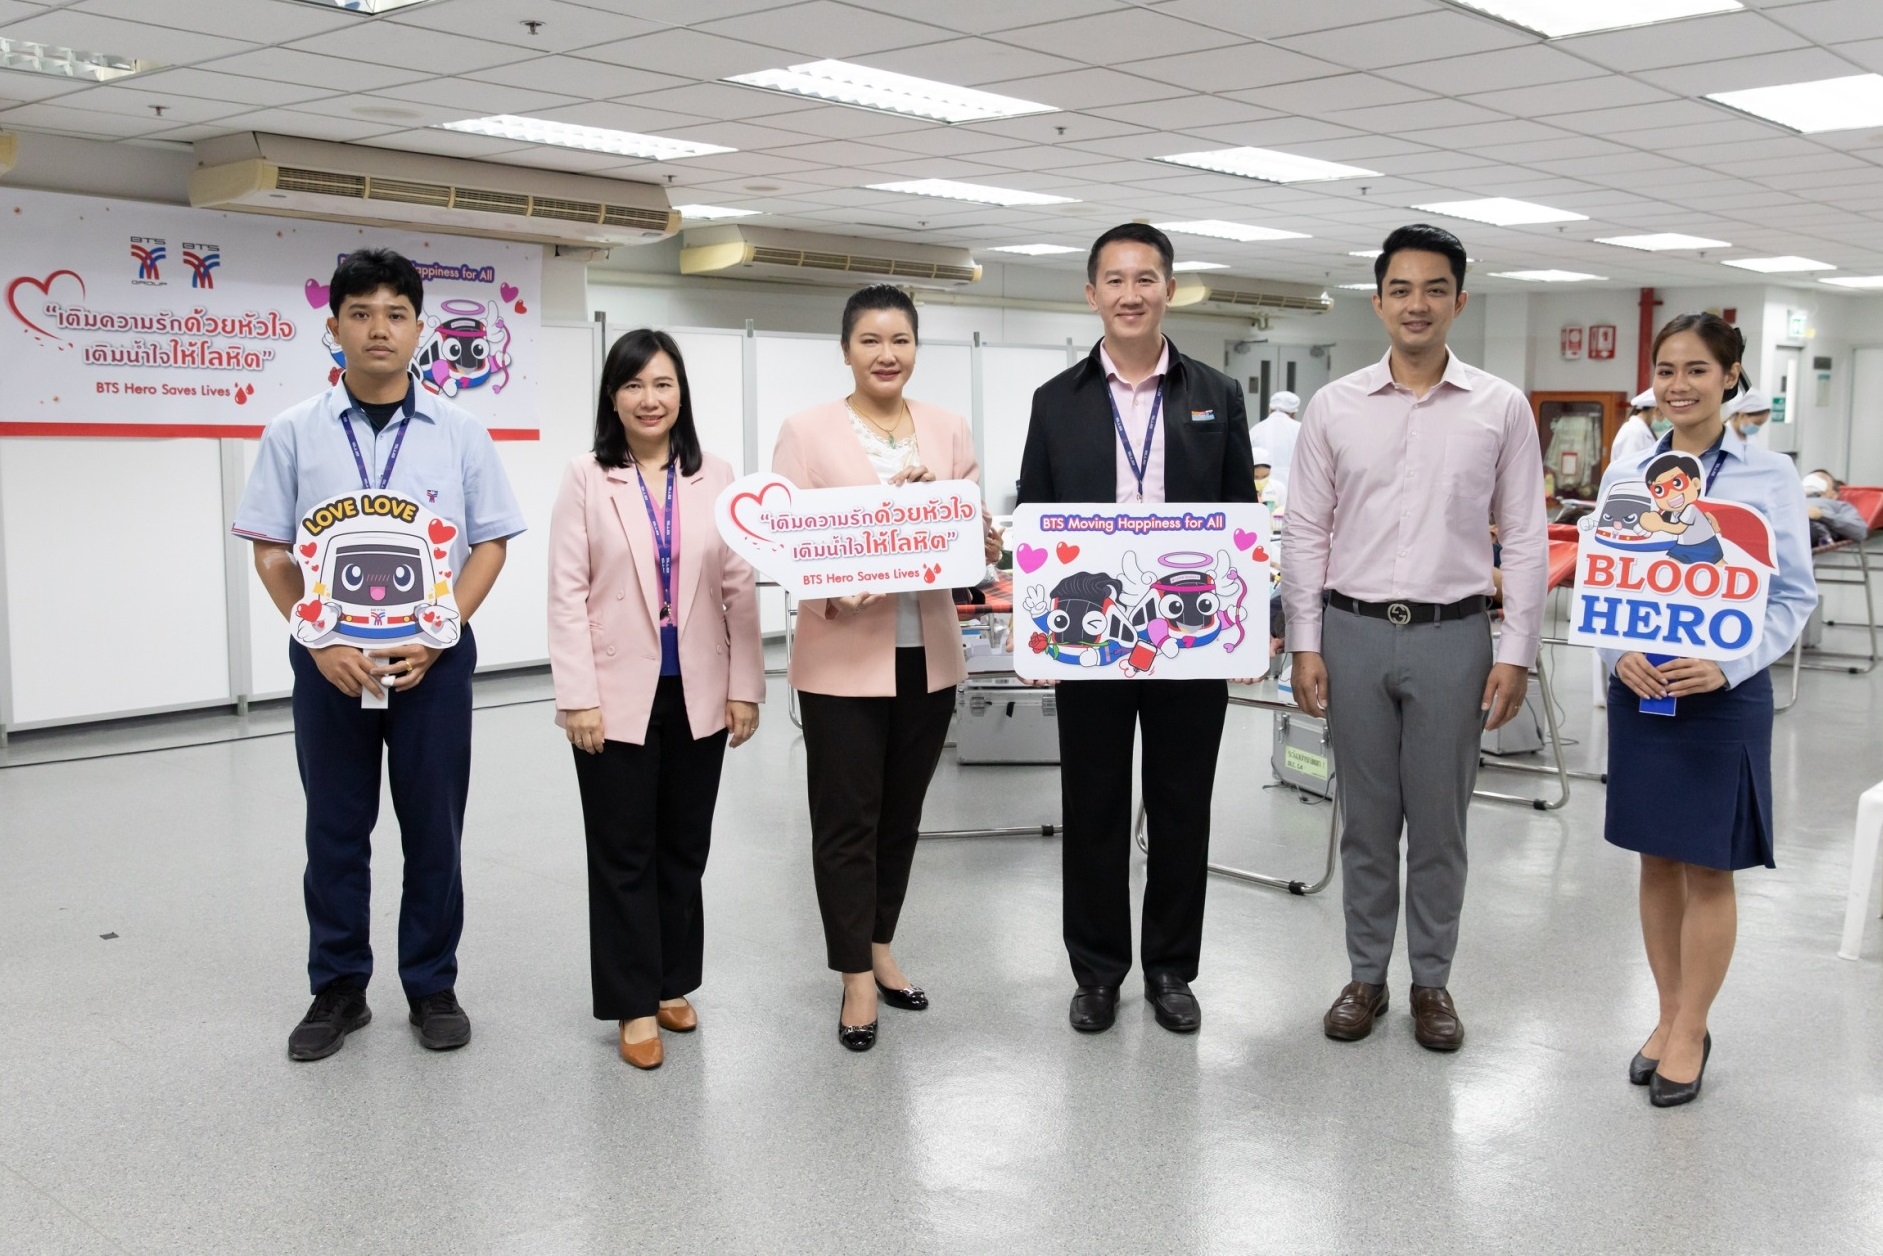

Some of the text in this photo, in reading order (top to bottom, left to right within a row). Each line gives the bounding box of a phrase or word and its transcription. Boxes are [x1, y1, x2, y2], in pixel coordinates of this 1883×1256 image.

[130, 236, 166, 246] BTS
[182, 242, 220, 252] BTS
[461, 267, 477, 279] for
[480, 269, 493, 281] All
[96, 382, 231, 397] BTS Hero Saves Lives
[305, 497, 417, 534] LOVE LOVE
[1043, 515, 1223, 533] BTS Moving Happiness for All
[803, 568, 920, 585] BTS Hero Saves Lives
[1583, 553, 1759, 601] BLOOD
[1577, 594, 1753, 650] HERO
